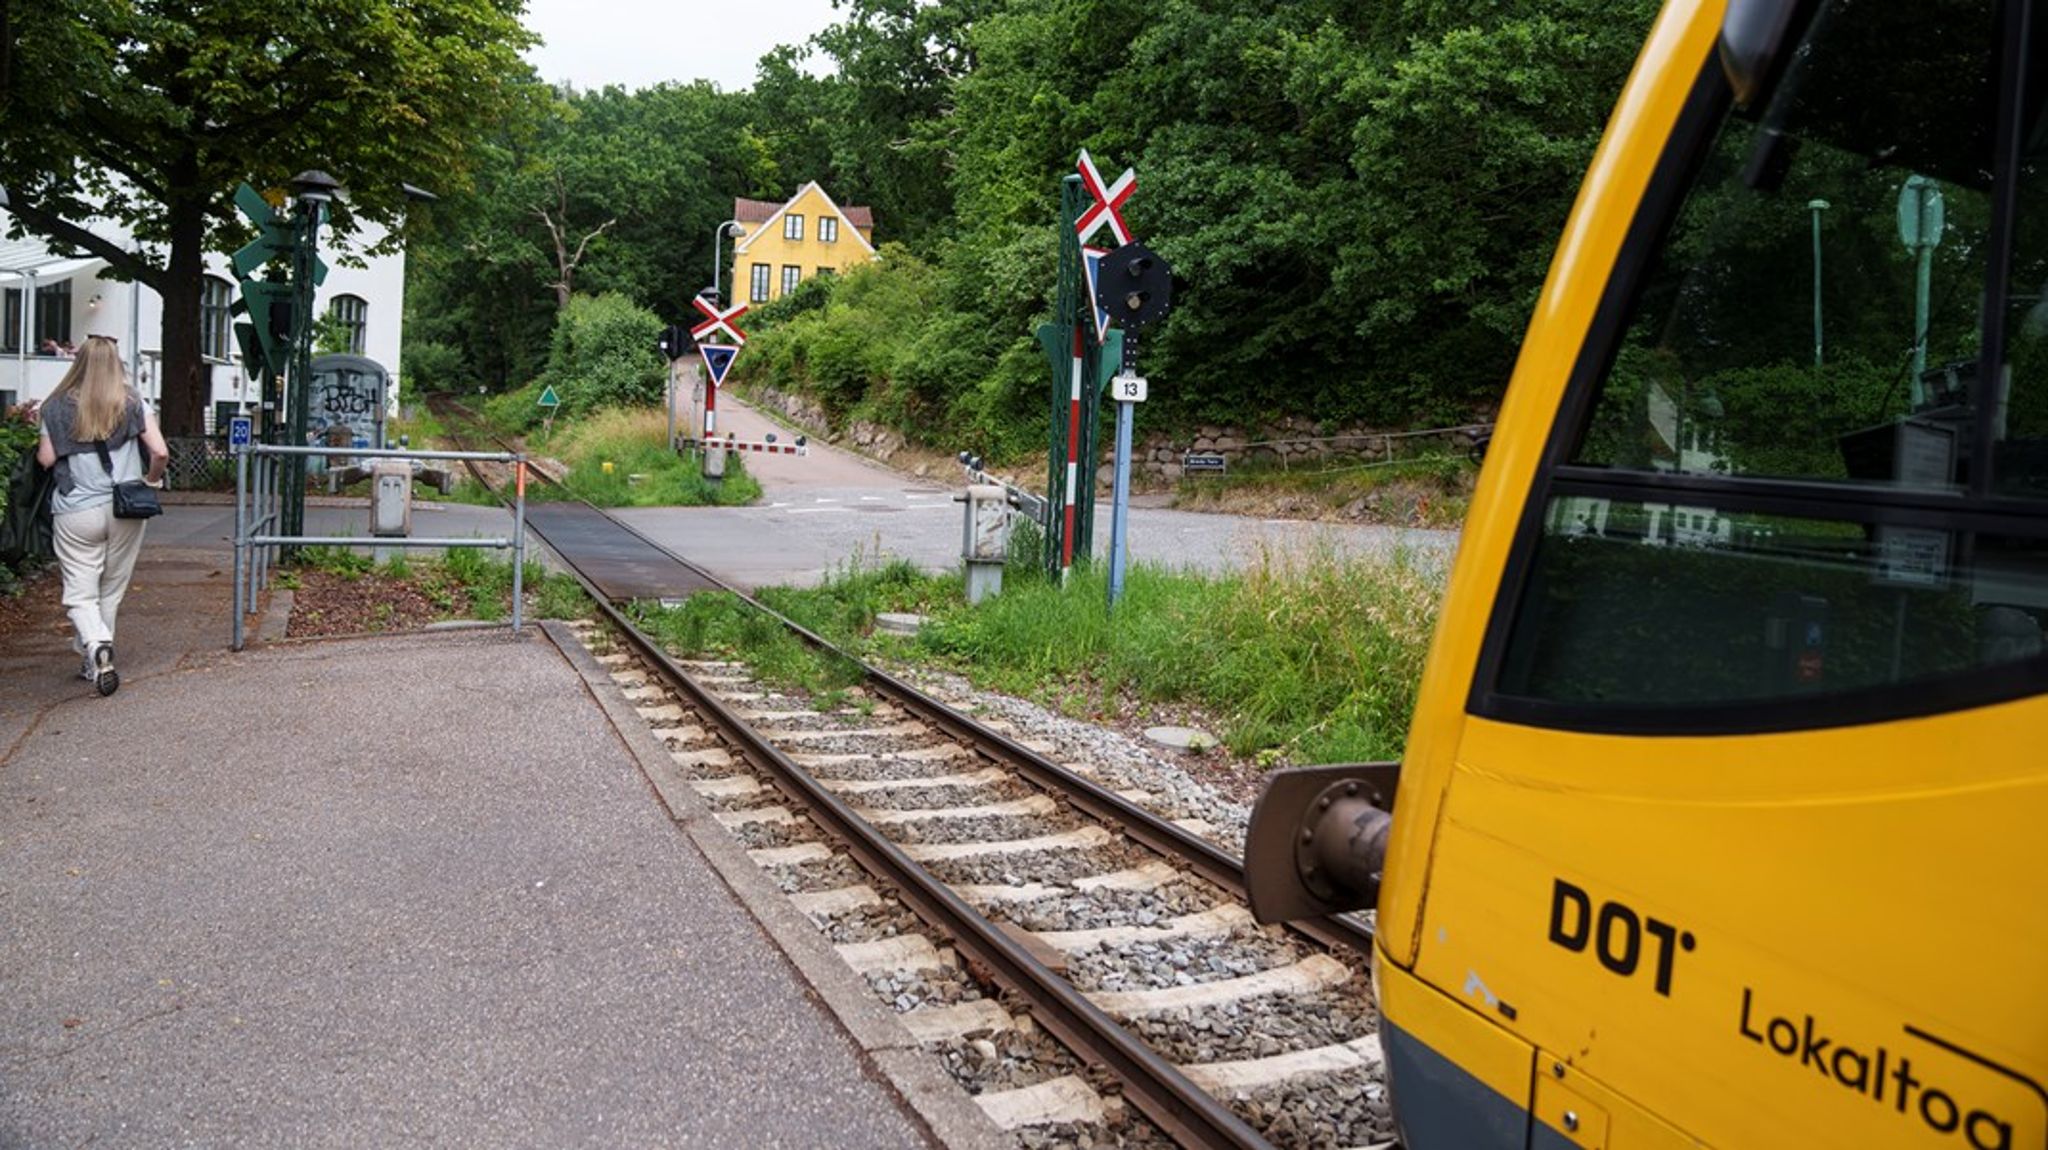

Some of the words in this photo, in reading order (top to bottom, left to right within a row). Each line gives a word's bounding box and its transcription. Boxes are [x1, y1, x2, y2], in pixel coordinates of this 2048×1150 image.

[1124, 382, 1138, 397] 13
[234, 425, 248, 438] 20
[1548, 877, 1696, 999] DOT
